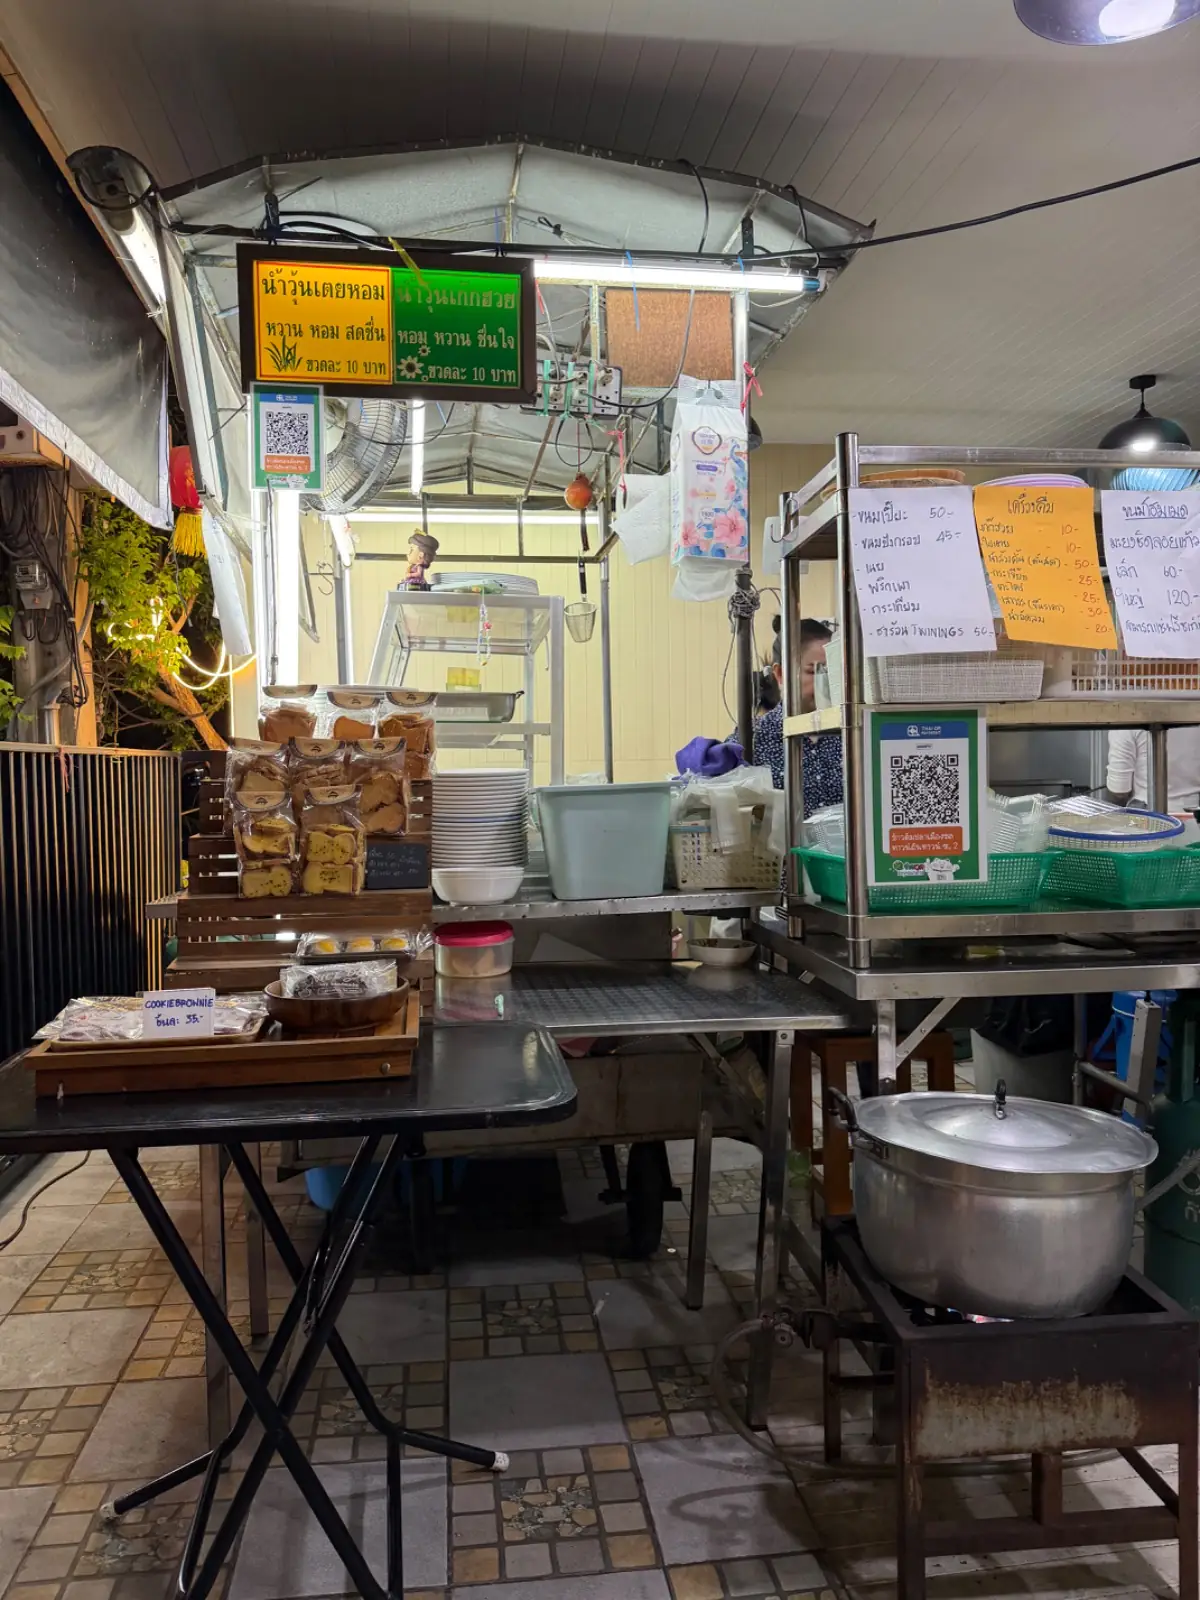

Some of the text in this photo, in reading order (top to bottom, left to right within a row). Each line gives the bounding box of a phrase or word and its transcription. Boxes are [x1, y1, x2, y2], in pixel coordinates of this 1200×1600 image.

[262, 268, 384, 305] น้ำวุ้นเตยหอม
[266, 316, 385, 341] หวาน หอม สดชื่น
[397, 324, 514, 349] หอม หวาน ชื่นใจ
[306, 360, 386, 375] ขวดละ 10 บาท
[428, 365, 516, 383] ขวดละ 10 บาท
[866, 562, 884, 574] เนย
[1116, 558, 1138, 578] เล็ก
[871, 597, 920, 614] กระเทียม
[1115, 587, 1144, 609] ใหญ่
[911, 624, 964, 638] TWININGS
